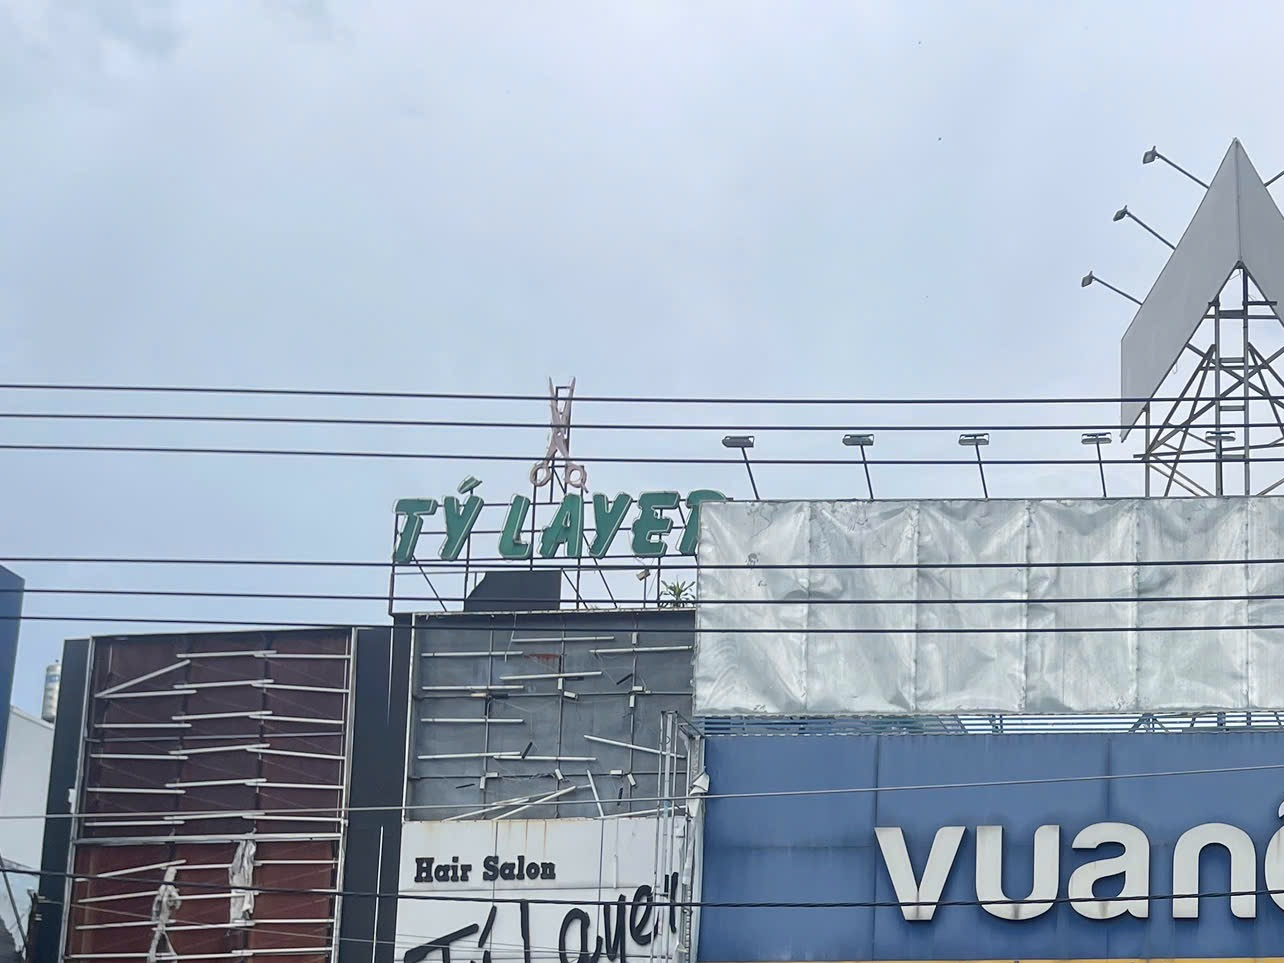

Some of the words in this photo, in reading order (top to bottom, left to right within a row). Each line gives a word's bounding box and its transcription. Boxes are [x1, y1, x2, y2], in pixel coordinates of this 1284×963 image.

[393, 475, 482, 564] TÝ
[414, 857, 472, 883] Hair
[483, 855, 556, 881] Salon
